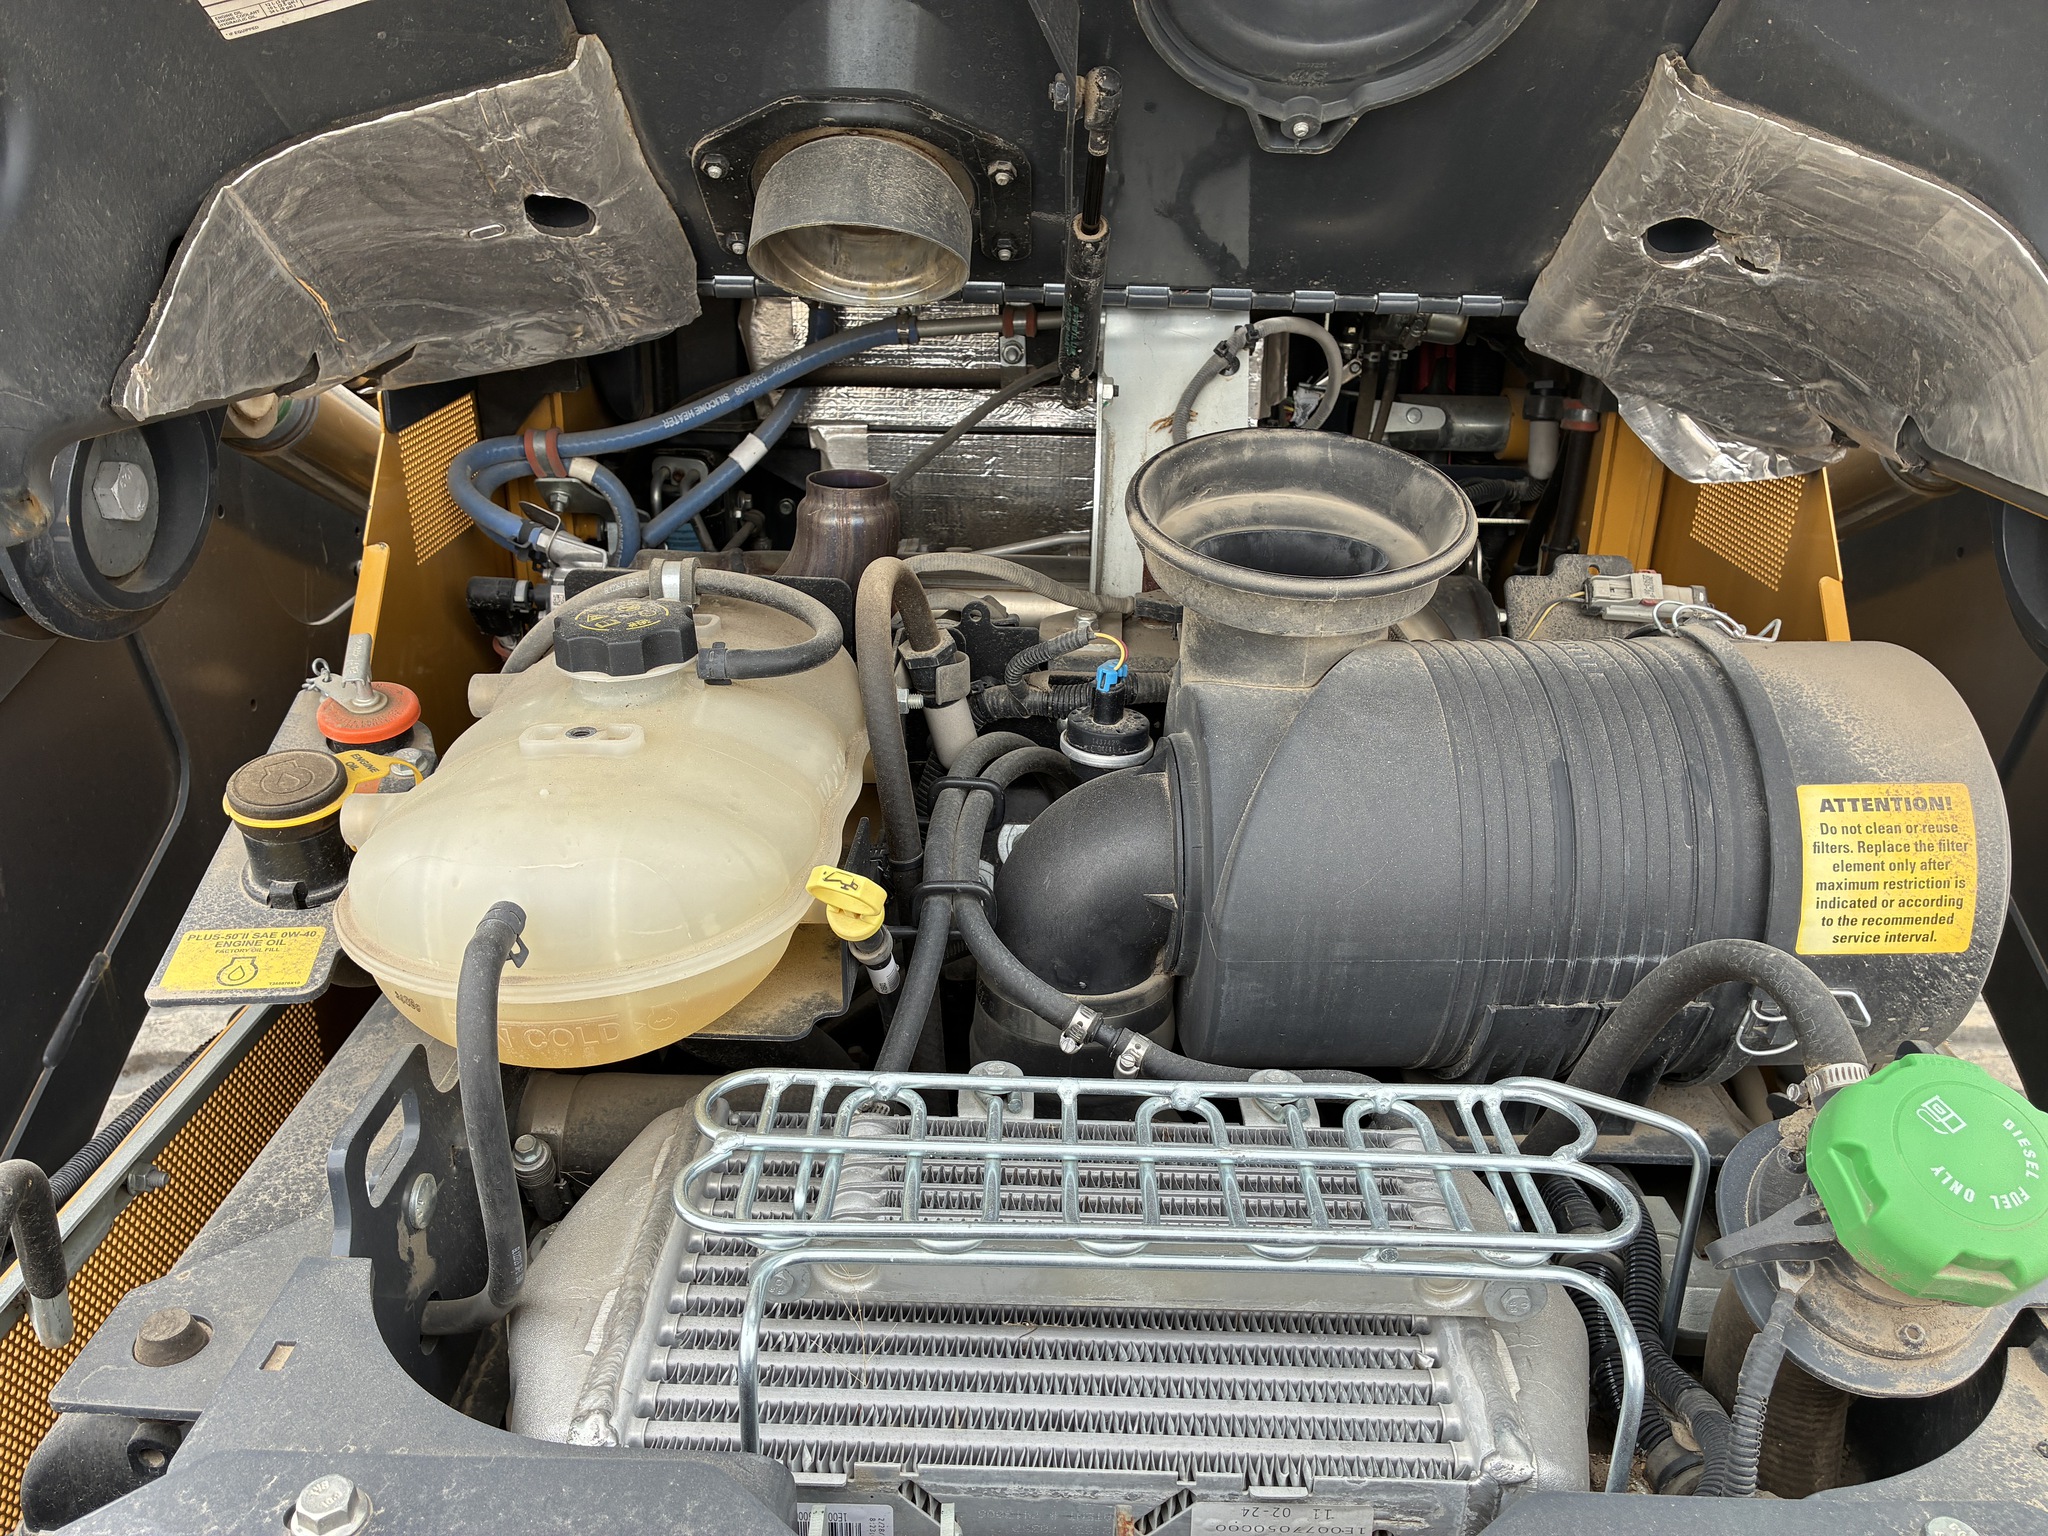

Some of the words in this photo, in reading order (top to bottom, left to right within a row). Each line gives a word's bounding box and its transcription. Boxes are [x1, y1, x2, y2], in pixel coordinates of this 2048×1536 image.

[236, 10, 260, 18] COOLANT
[220, 18, 247, 27] HYDRAULIC
[234, 26, 259, 34] EQUIPPED
[694, 392, 731, 416] SILICONE
[662, 409, 695, 429] HEATER
[345, 761, 359, 771] OIL
[351, 753, 380, 773] ENGINE
[1820, 796, 1953, 813] ATTENTION!
[1820, 822, 1838, 835] Do
[1841, 824, 1862, 835] not
[1865, 822, 1902, 835] clean
[1905, 825, 1919, 834] or
[1922, 823, 1958, 834] reuse
[1812, 840, 1854, 854] filters.
[1858, 840, 1911, 856] Replace
[1913, 840, 1934, 852] the
[1938, 840, 1968, 852] filter
[1832, 859, 1885, 873] element
[1888, 859, 1916, 874] only
[1920, 859, 1950, 872] after
[1816, 878, 1880, 891] maximum
[1883, 878, 1950, 890] restriction
[1954, 878, 1966, 888] is
[1816, 896, 1877, 909] indicated
[1881, 898, 1895, 908] or
[1898, 896, 1963, 909] according
[1821, 915, 1833, 927] to
[1837, 915, 1858, 927] the
[1862, 913, 1954, 926] recommended
[1832, 932, 1881, 944] service
[1884, 931, 1937, 943] interval.
[524, 1022, 622, 1048] COLD
[2001, 1118, 2040, 1180] DIESEL
[1930, 1165, 1976, 1203] ONLY
[1989, 1185, 2031, 1210] FUEL
[1241, 1507, 1291, 1518] 02-24
